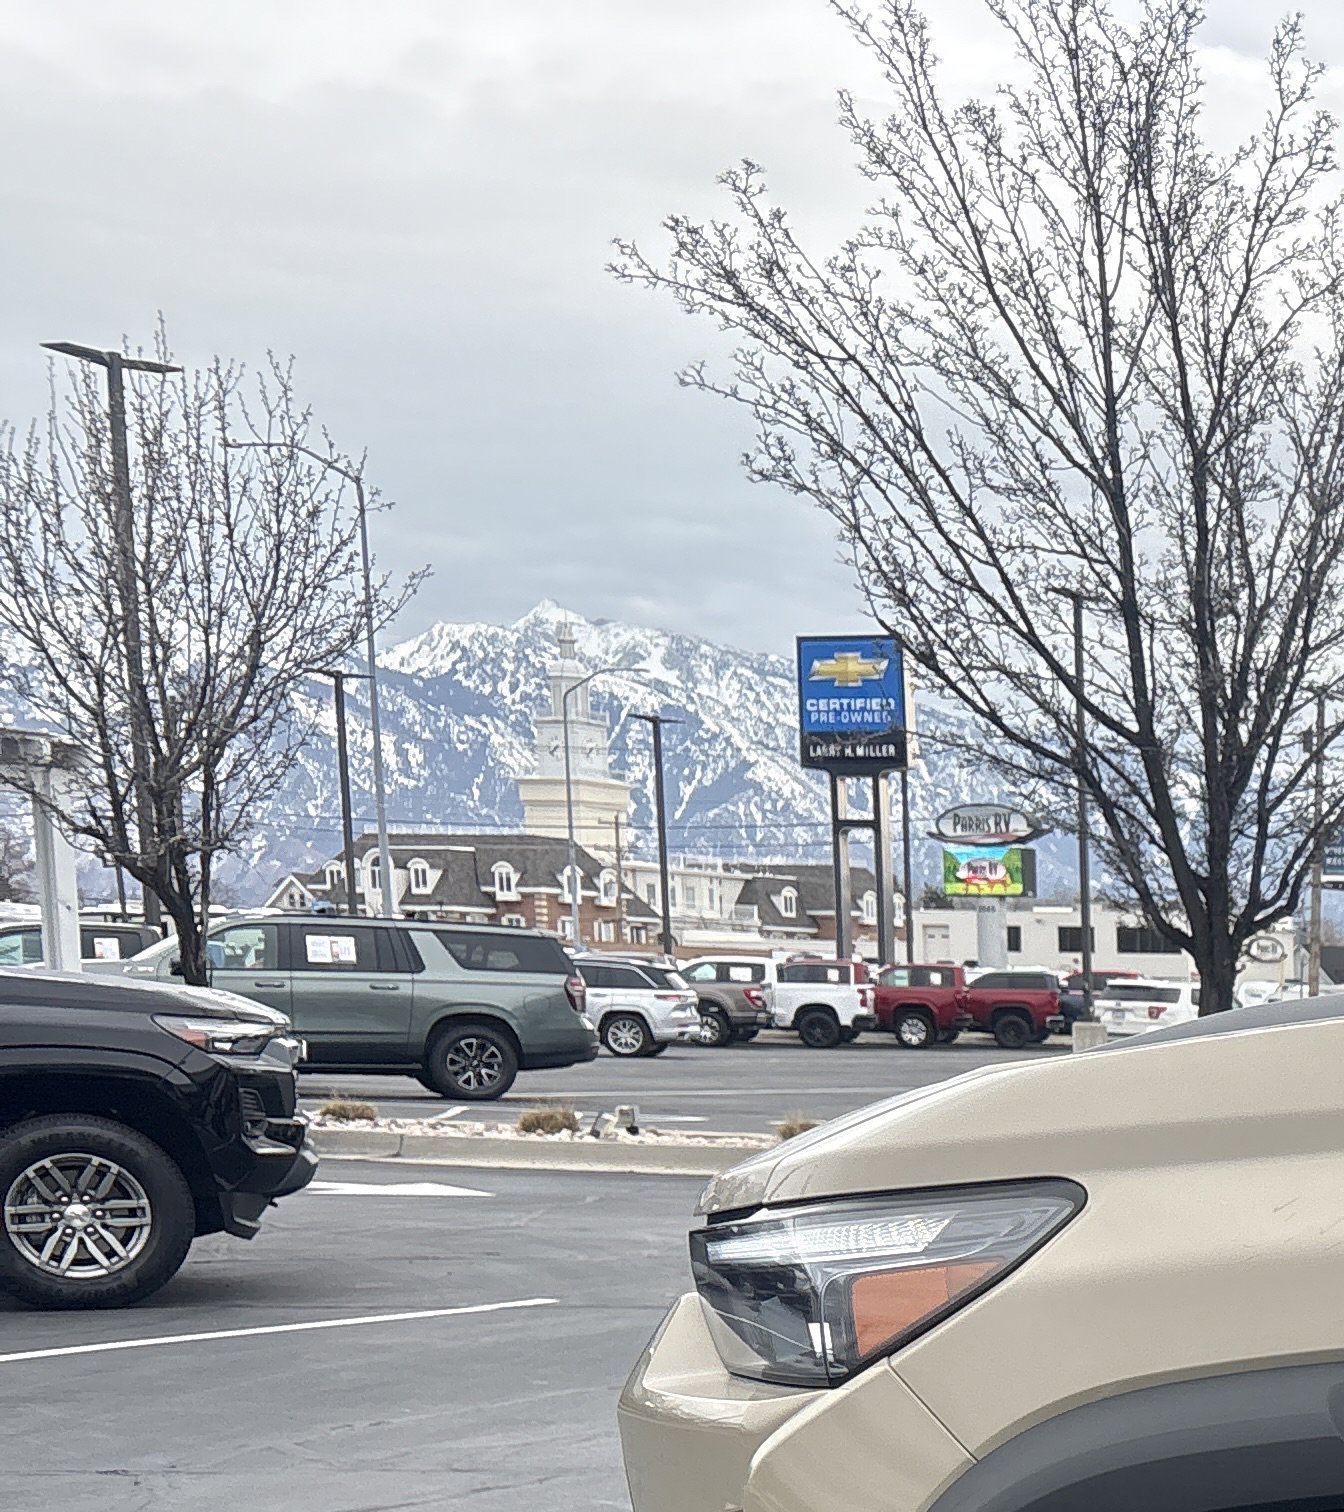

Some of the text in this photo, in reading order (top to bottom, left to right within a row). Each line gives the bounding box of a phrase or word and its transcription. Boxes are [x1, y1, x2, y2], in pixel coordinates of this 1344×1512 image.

[806, 697, 895, 711] CERTIFIED
[811, 711, 892, 723] PRE-OWNED
[856, 743, 896, 758] MILLER
[993, 811, 1011, 834] RV
